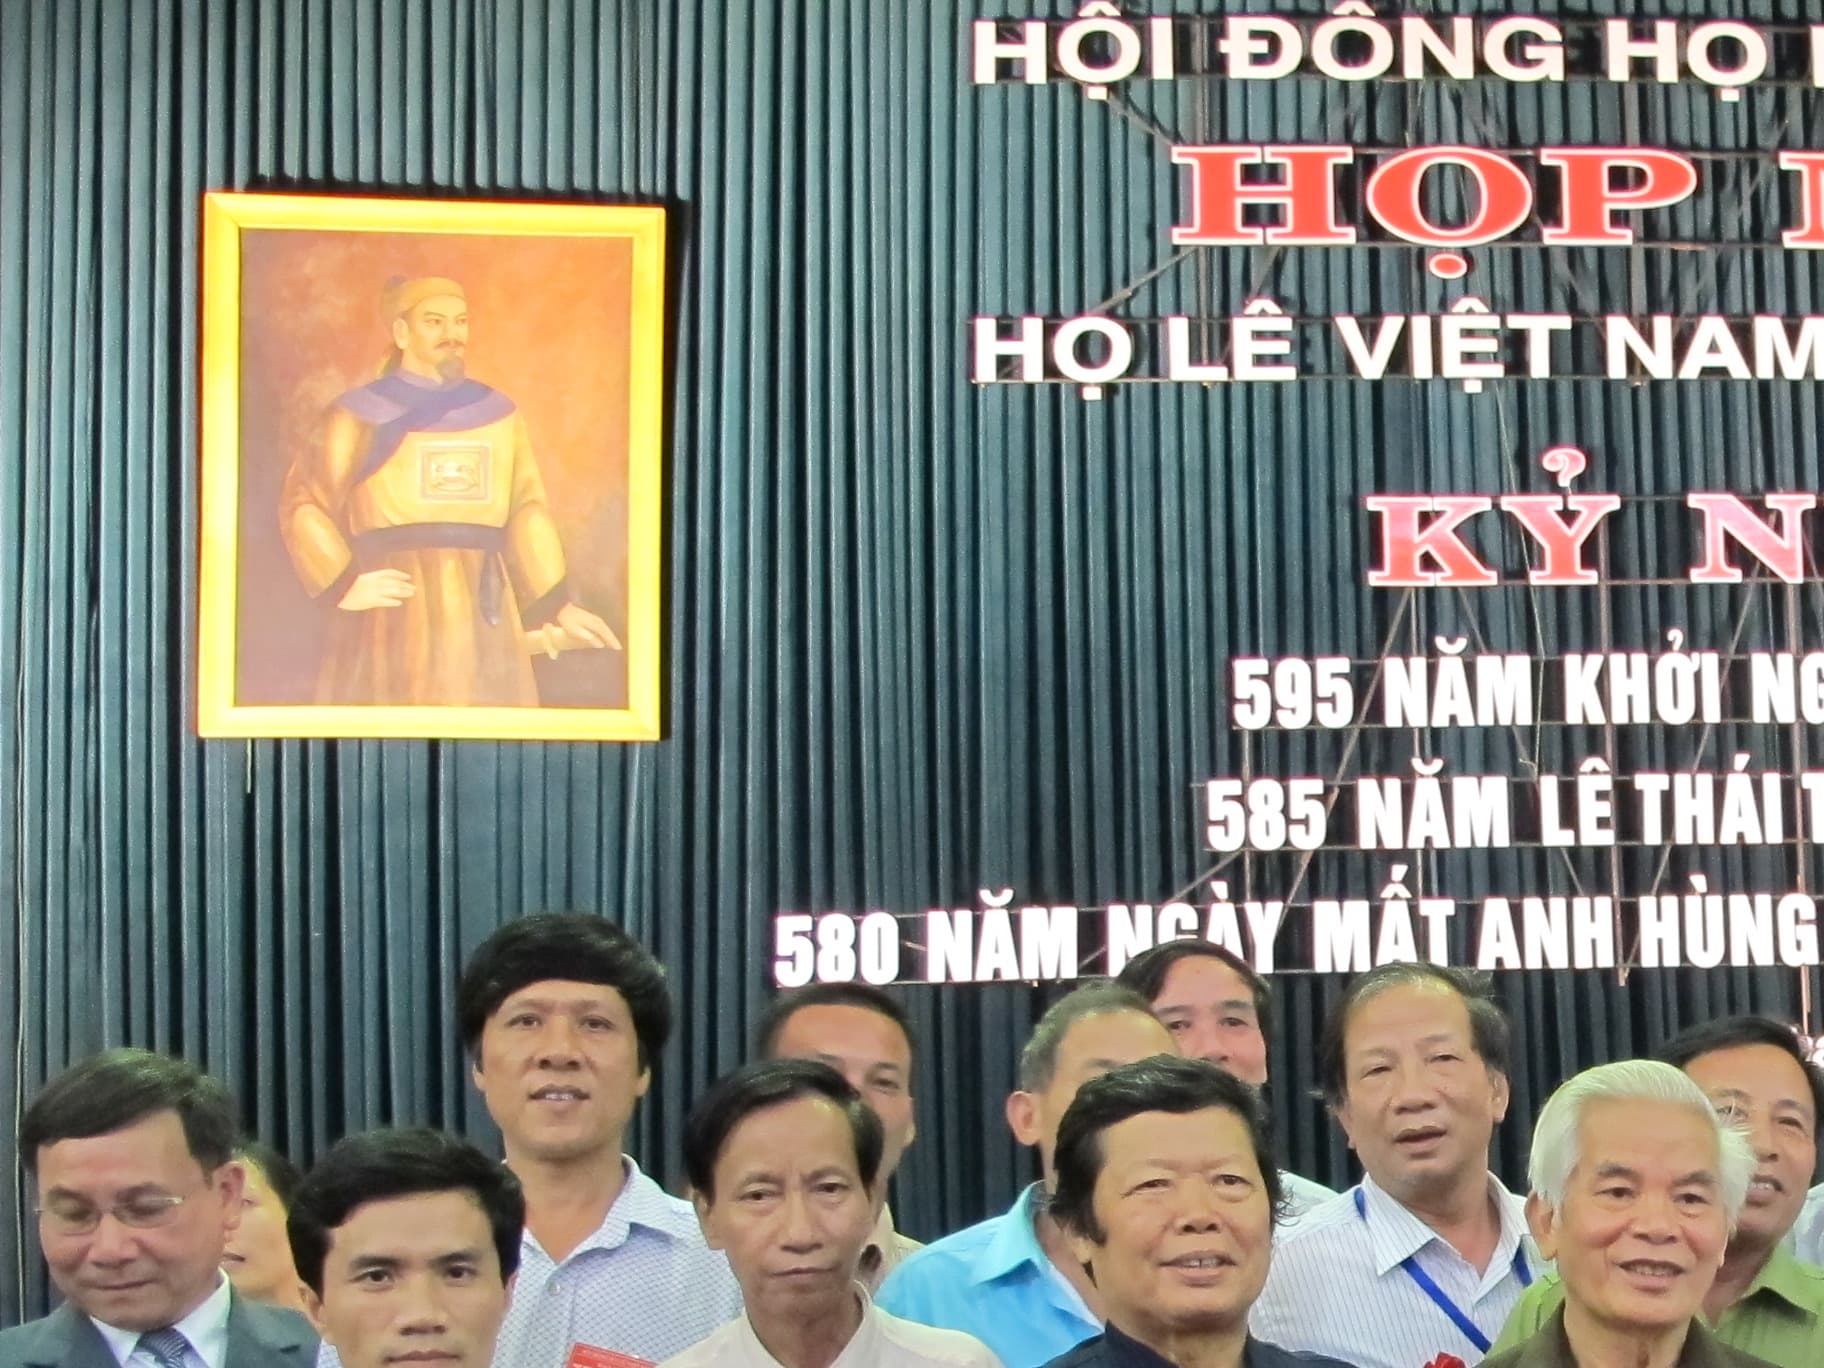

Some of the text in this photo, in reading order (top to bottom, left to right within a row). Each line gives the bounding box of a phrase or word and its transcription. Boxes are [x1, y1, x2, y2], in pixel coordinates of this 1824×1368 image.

[973, 0, 1174, 100] HỘI
[1606, 20, 1767, 102] HỌ
[1171, 145, 1698, 279] HỌP
[973, 315, 1133, 400] HỌ
[1167, 298, 1297, 381] LÊ
[1335, 297, 1572, 393] VIỆT
[1367, 447, 1621, 586] KỶ
[1233, 656, 1354, 730] 595
[1384, 636, 1533, 728] NĂM
[1564, 629, 1721, 726] KHỞI
[1206, 777, 1327, 852] 585
[1357, 756, 1511, 850] NĂM
[1540, 757, 1615, 847] LÊ
[1633, 754, 1784, 845] THÁI
[774, 911, 900, 988] 580
[927, 888, 1079, 983] NĂM
[1314, 865, 1456, 972] MẤT
[1478, 896, 1617, 972] ANH
[1640, 874, 1820, 969] HÙNG
